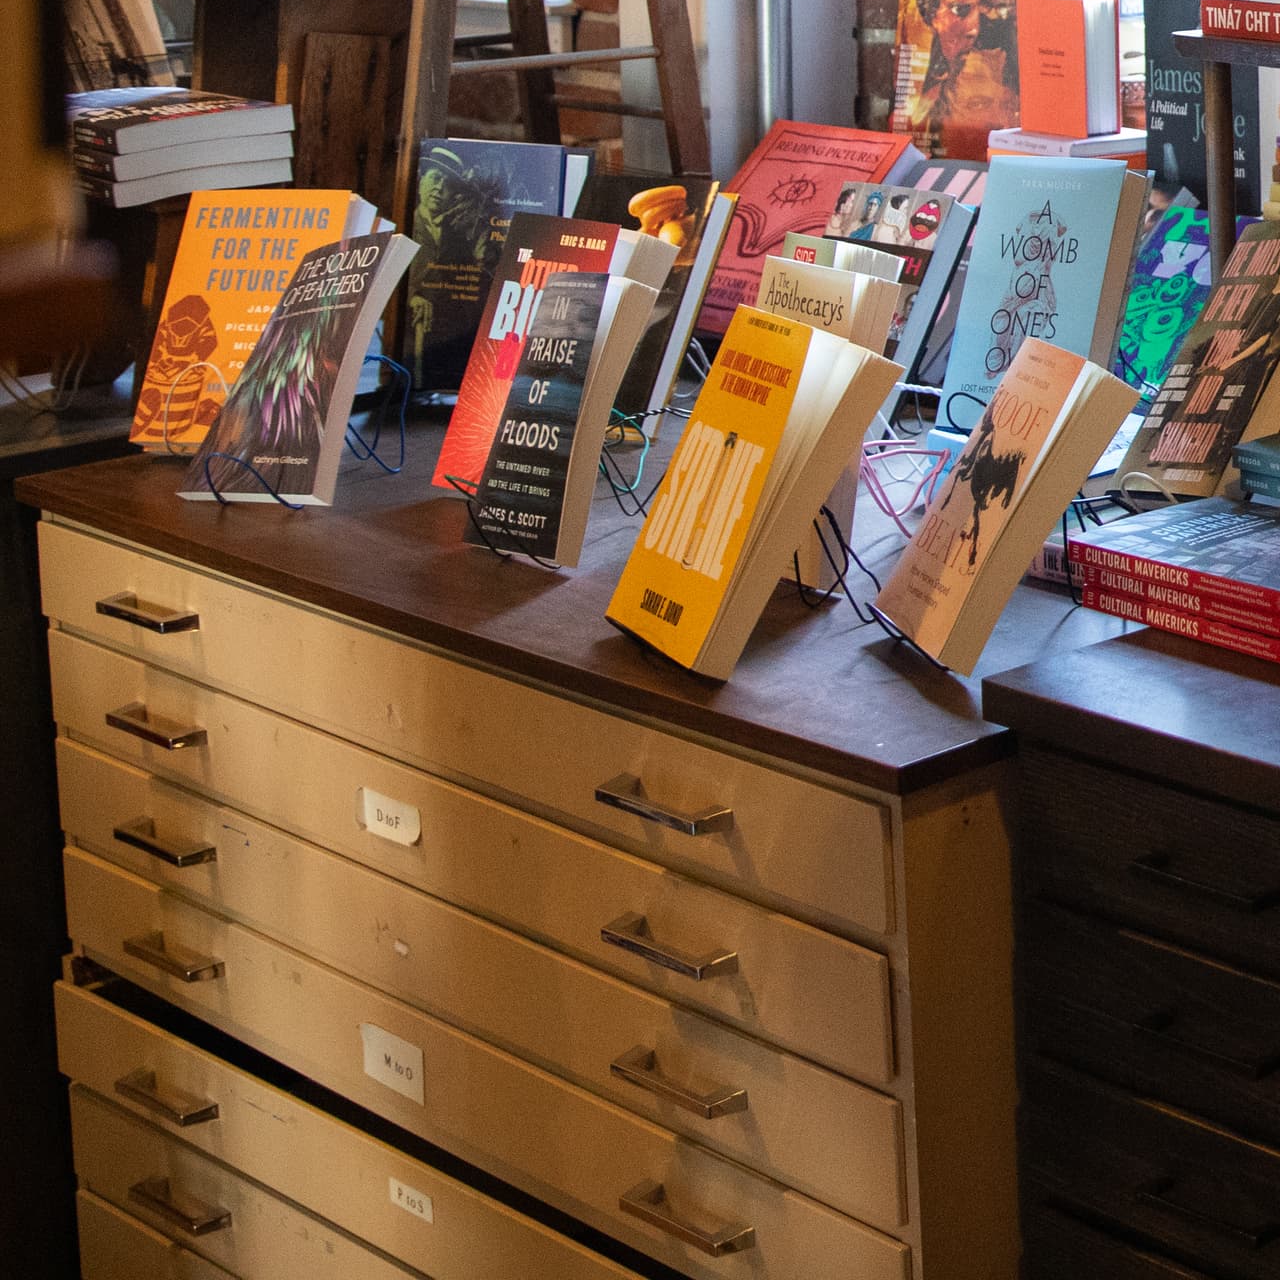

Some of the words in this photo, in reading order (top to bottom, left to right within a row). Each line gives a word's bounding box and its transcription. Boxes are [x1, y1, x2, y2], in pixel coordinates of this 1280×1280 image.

[1206, 4, 1241, 30] TINÁ7
[1245, 9, 1270, 32] CHT
[1148, 60, 1202, 97] James
[1150, 116, 1165, 131] Life
[775, 139, 828, 156] READING
[828, 146, 882, 163] PICTURES
[195, 207, 330, 230] FERMENTING
[1037, 199, 1053, 224] A
[211, 237, 251, 260] FOR
[258, 238, 299, 261] THE
[560, 234, 577, 247] ERIC
[578, 236, 585, 249] S.
[585, 238, 607, 251] HAAG
[1001, 234, 1079, 264] WOMB
[297, 261, 326, 282] THE
[325, 246, 380, 272] SOUND
[206, 269, 289, 293] FUTURE
[283, 287, 307, 308] OF
[304, 272, 369, 301] FEATHERS
[779, 272, 791, 289] The
[1015, 271, 1050, 300] OF
[552, 295, 571, 320] IN
[765, 276, 845, 326] Apothecary's
[991, 308, 1059, 339] ONE'S
[526, 337, 577, 365] PRAISE
[528, 381, 550, 404] OF
[500, 420, 561, 451] FLOODS
[496, 460, 506, 470] THE
[506, 460, 532, 473] UNTAMED
[533, 465, 550, 476] RIVER
[507, 510, 516, 524] C.
[517, 511, 547, 529] SCOTT
[640, 588, 660, 619] SARAH
[665, 600, 684, 627] BOND
[1099, 593, 1142, 620] CULTURAL
[1146, 609, 1199, 637] MAVERICKS
[376, 808, 385, 822] D
[385, 813, 395, 826] to
[394, 815, 401, 830] F
